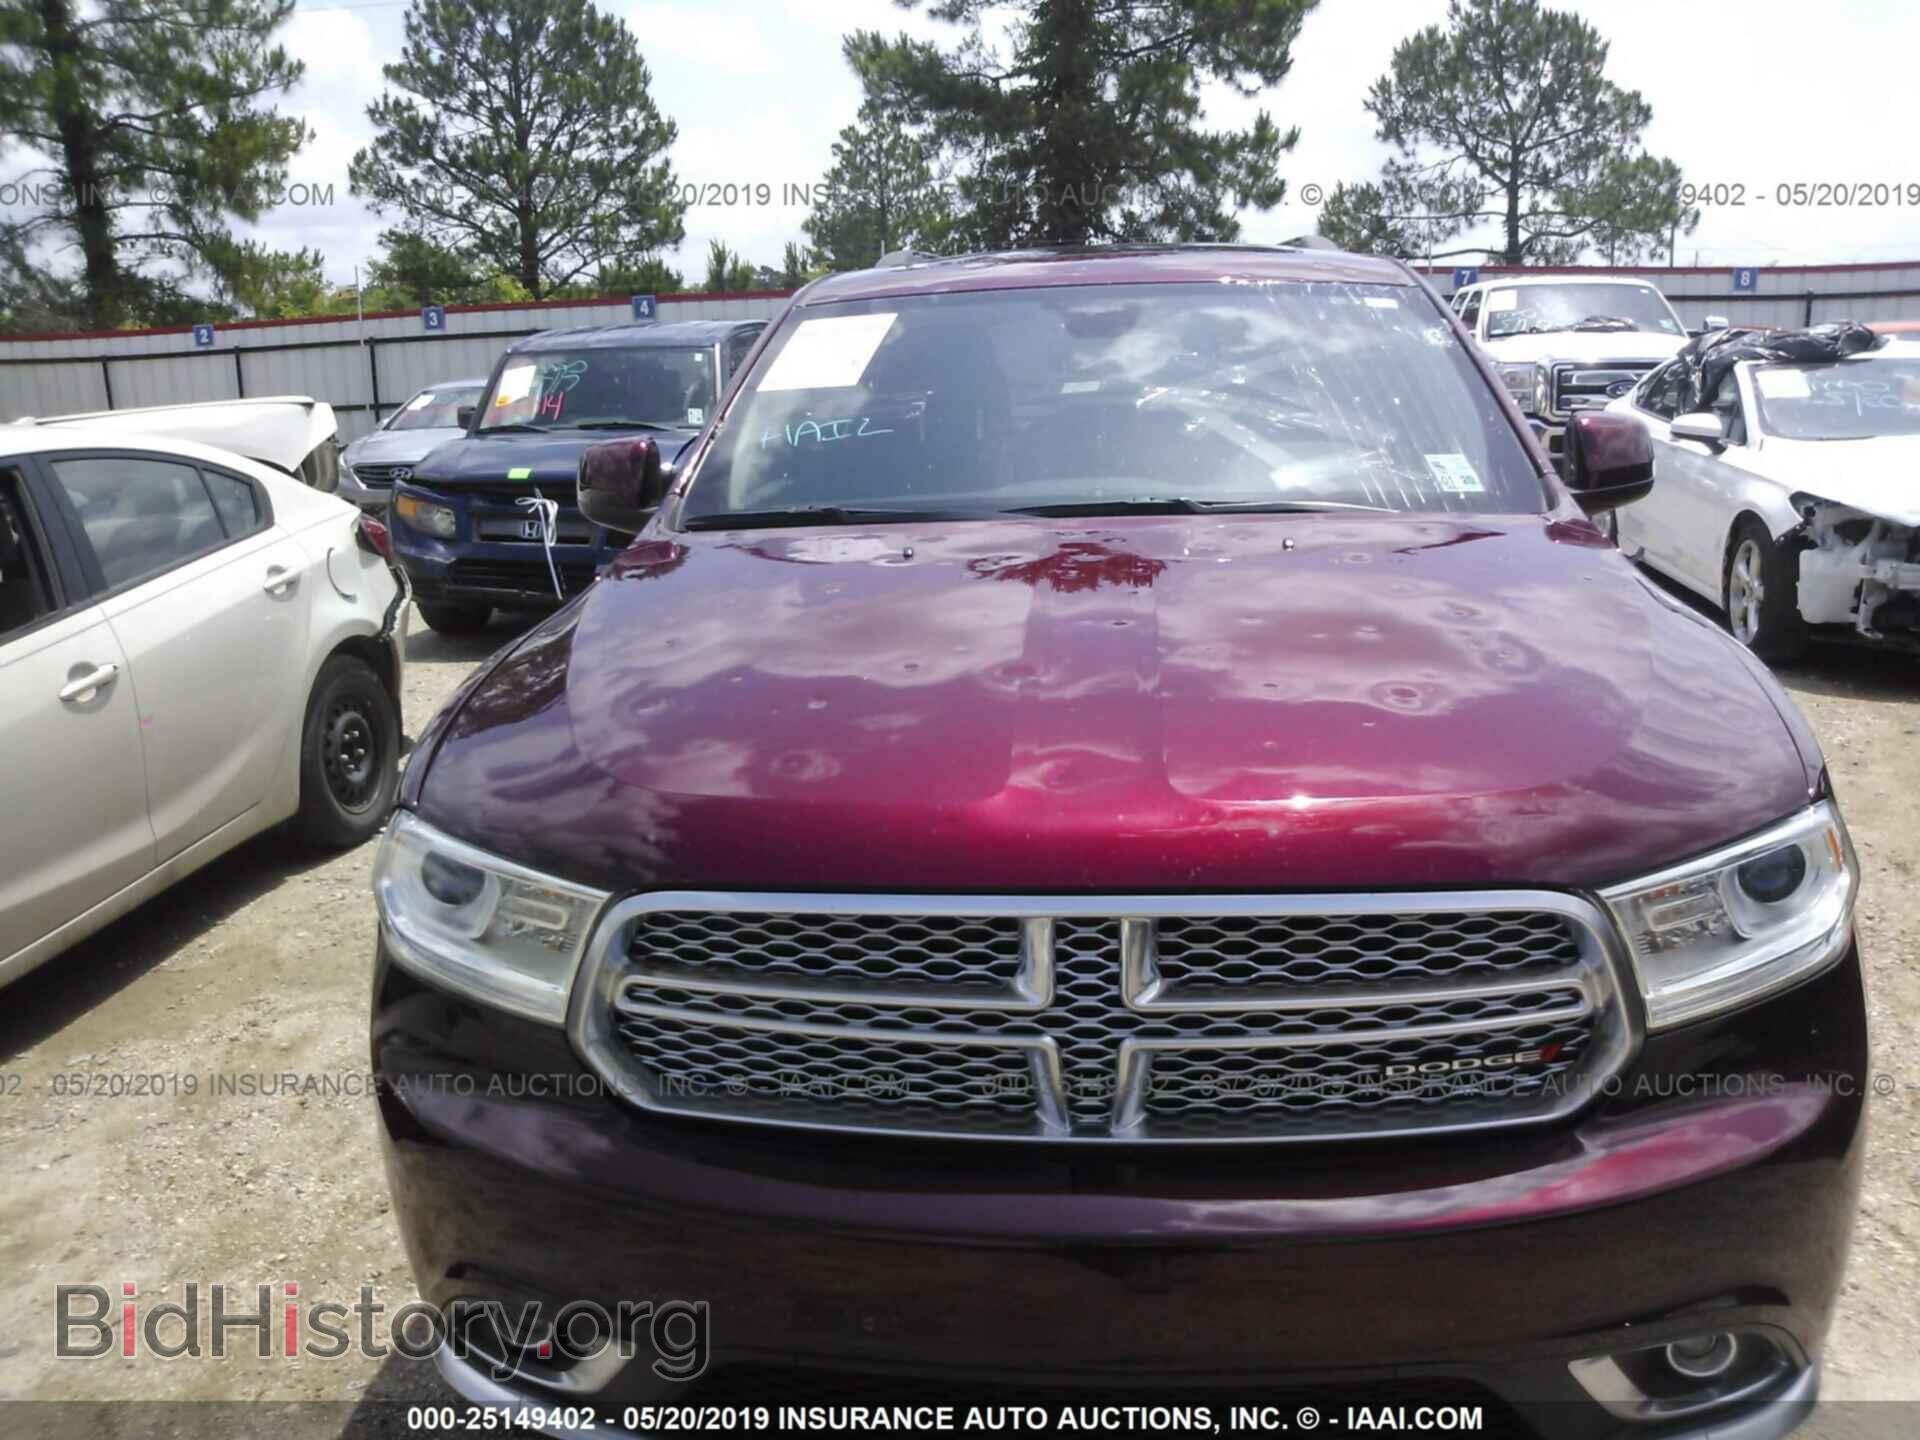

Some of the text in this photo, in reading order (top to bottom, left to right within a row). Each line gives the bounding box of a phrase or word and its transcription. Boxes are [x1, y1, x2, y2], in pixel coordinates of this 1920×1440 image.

[1461, 270, 1471, 285] 7
[1740, 270, 1750, 286] 8
[639, 299, 649, 315] 4
[429, 311, 438, 326] 3
[200, 328, 209, 343] 2
[1384, 1050, 1541, 1076] DODGE
